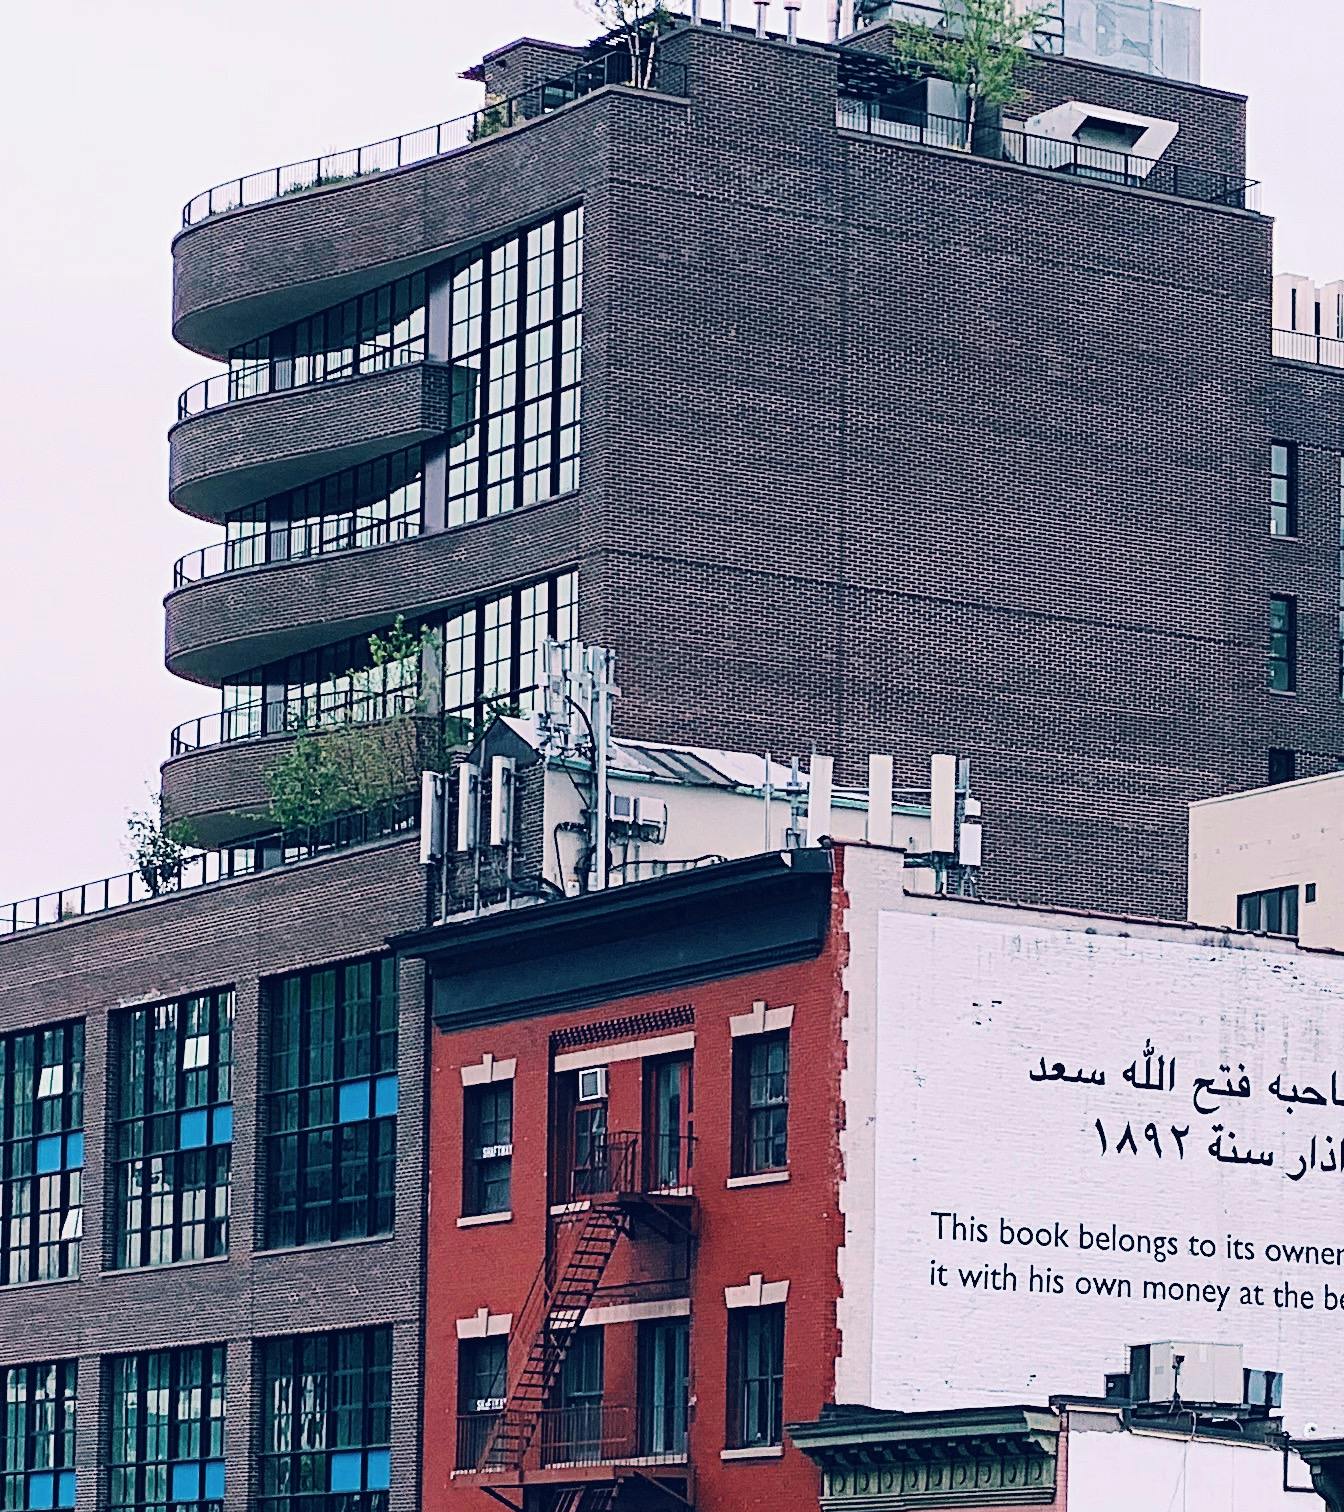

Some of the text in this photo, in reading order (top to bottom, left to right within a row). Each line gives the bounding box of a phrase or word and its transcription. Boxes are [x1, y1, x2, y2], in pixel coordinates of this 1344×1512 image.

[1029, 1056, 1106, 1086] سعد
[1122, 1038, 1176, 1092] الله
[1192, 1062, 1251, 1115] فتح
[1094, 1117, 1190, 1160] ١٨٩٢
[1207, 1123, 1274, 1167] سنة
[930, 1212, 988, 1244] This
[1000, 1217, 1069, 1248] book
[1079, 1223, 1178, 1263] belongs
[1188, 1235, 1216, 1258] to
[1226, 1234, 1255, 1261] its
[930, 1260, 948, 1287] it
[958, 1263, 1017, 1292] with
[1029, 1264, 1064, 1294] his
[1075, 1276, 1131, 1298] own
[1143, 1280, 1230, 1312] money
[1240, 1285, 1264, 1306] at
[1274, 1281, 1314, 1309] the
